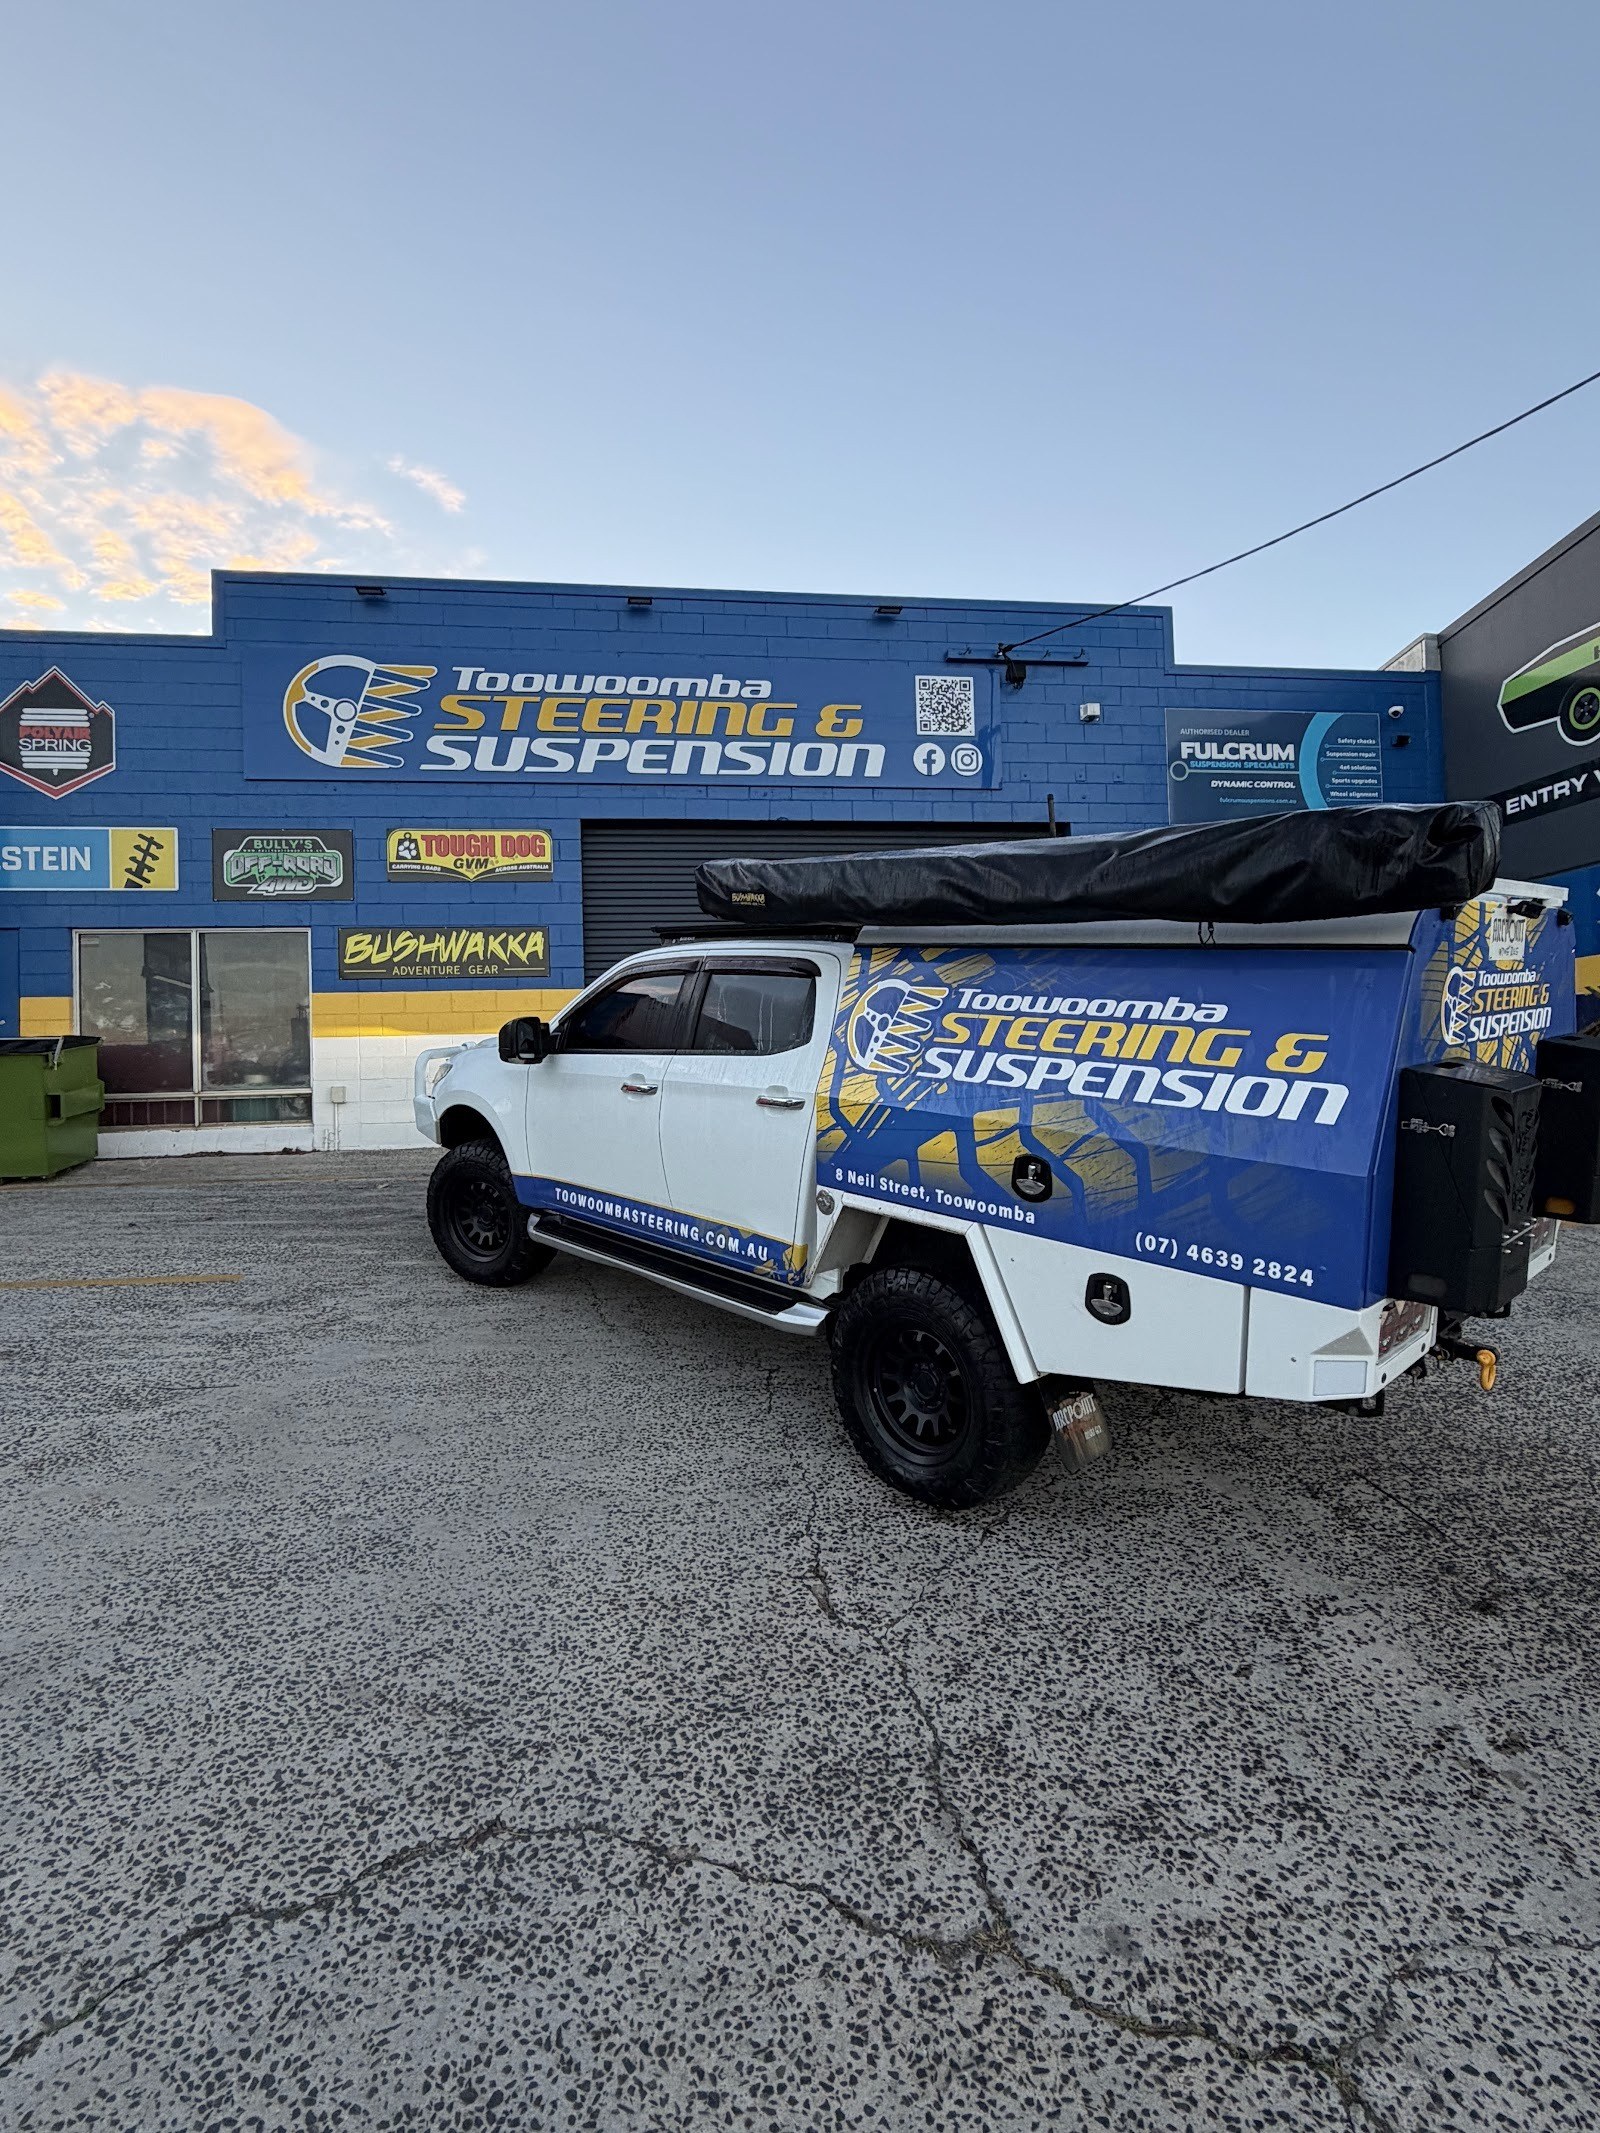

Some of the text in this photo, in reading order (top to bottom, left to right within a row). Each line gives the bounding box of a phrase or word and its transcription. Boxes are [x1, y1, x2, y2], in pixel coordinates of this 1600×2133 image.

[452, 666, 772, 698] Toowoomba
[434, 694, 863, 738] STEERING &
[19, 726, 91, 740] POLYAIR
[1180, 728, 1223, 736] AUTHORISED
[1337, 737, 1356, 745] Safety
[18, 738, 92, 752] SPRING
[420, 735, 886, 777] SUSPENSION
[1180, 741, 1295, 761] FULCRUM
[1189, 760, 1295, 770] SUSPENSION SPECIALISTS
[1210, 780, 1296, 789] DYNAMIC CONTROL
[1506, 773, 1588, 815] ENTRY
[253, 839, 313, 849] BULLY'S
[421, 834, 546, 858] TOUGH DOG
[0, 845, 91, 872] STEIN
[453, 858, 490, 869] GVM
[495, 865, 517, 873] ACROSS
[256, 878, 315, 892] 4WD
[343, 929, 546, 966] BUSHWAKKA
[392, 964, 499, 976] ADVENTURE GEAR
[1478, 968, 1537, 987] Toowoomba
[958, 987, 1228, 1023] Toowoomba
[1472, 983, 1550, 1014] STEERING &
[1467, 1006, 1552, 1043] SUSPENSION
[933, 1012, 1330, 1074] STEERING &
[916, 1046, 1350, 1126] SUSPENSION
[835, 1168, 1036, 1225] 8 Neil Street, Toowoomba
[555, 1187, 769, 1262] TOOWOOMBASTEERING.COM.AU
[1135, 1231, 1315, 1287] (07) 4639 2824
